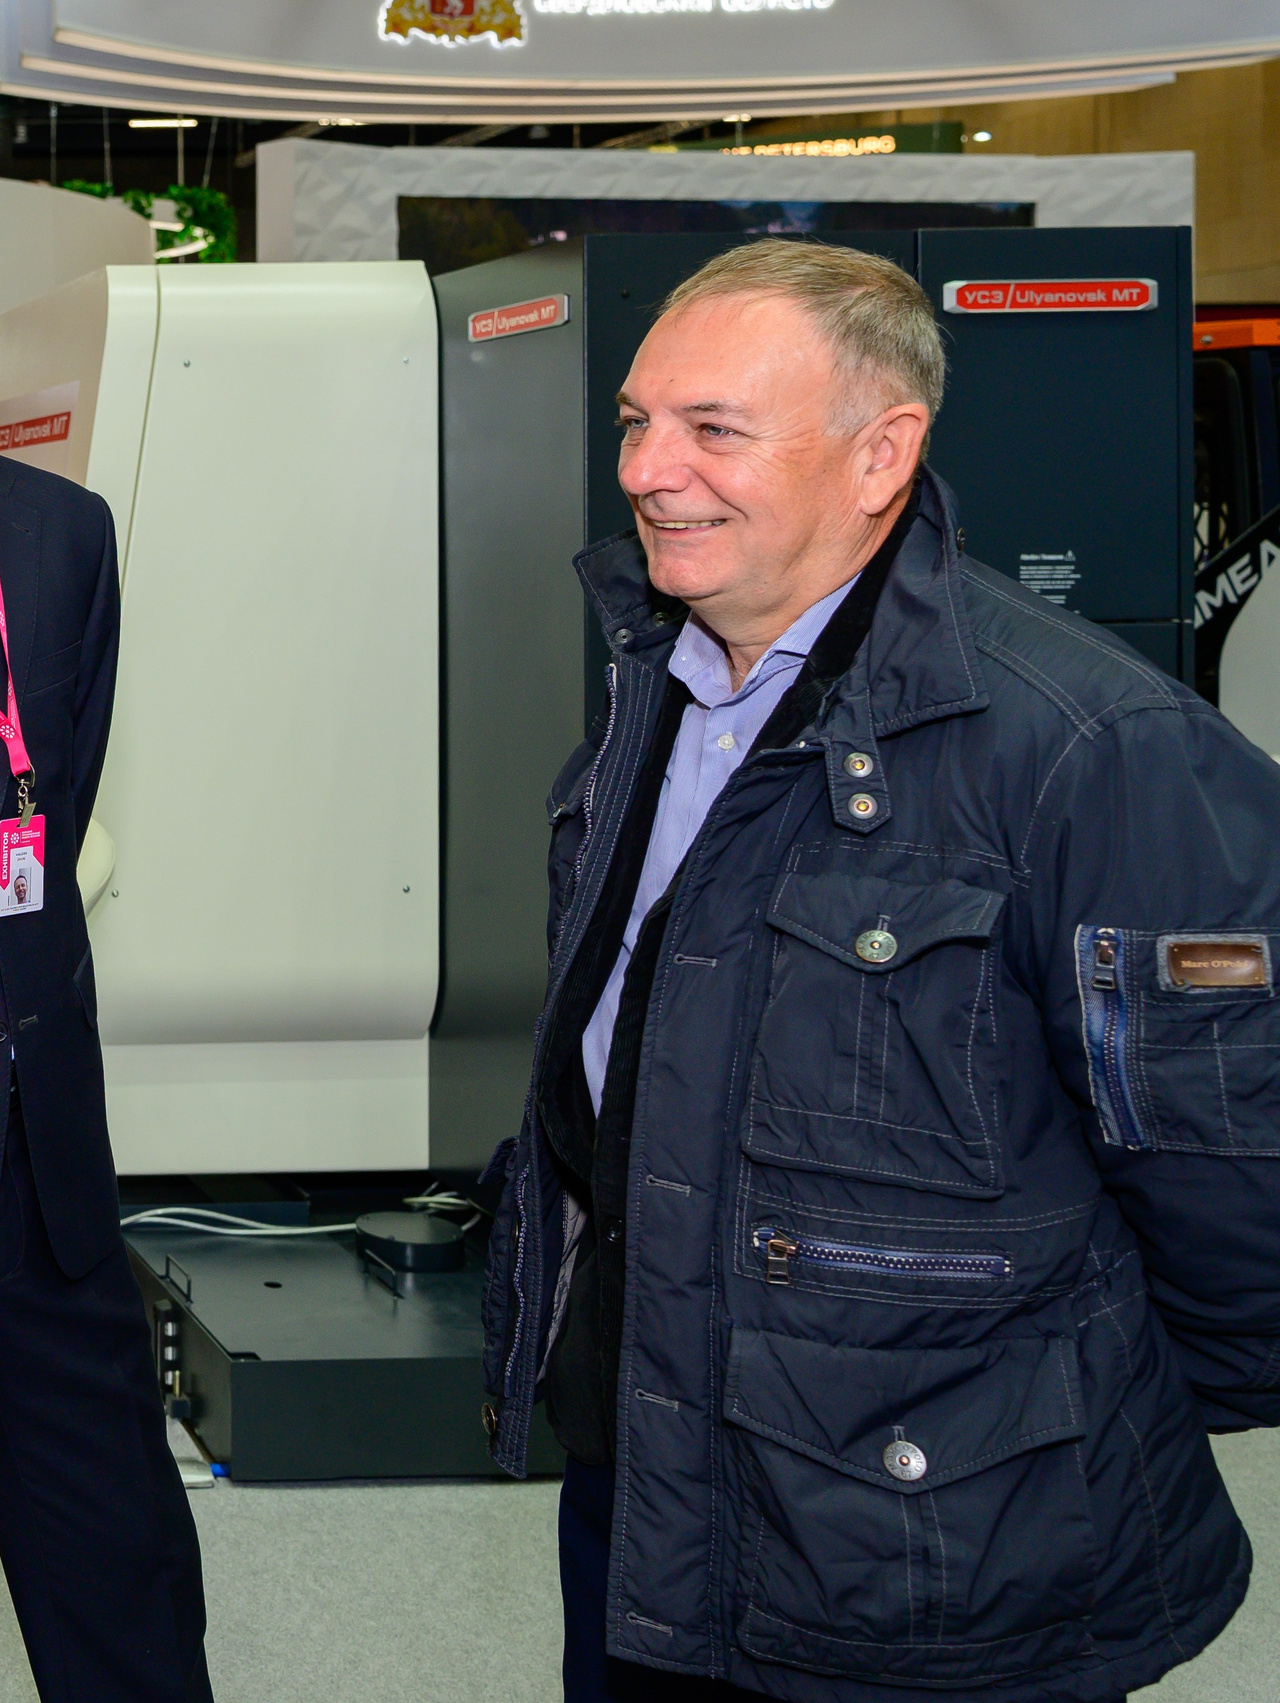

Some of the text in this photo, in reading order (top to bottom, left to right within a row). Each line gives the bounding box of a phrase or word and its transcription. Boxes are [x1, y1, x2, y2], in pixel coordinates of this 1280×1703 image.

[1112, 288, 1140, 301] MT
[1, 831, 9, 880] EXHIBITOR
[1181, 960, 1210, 968] Marc
